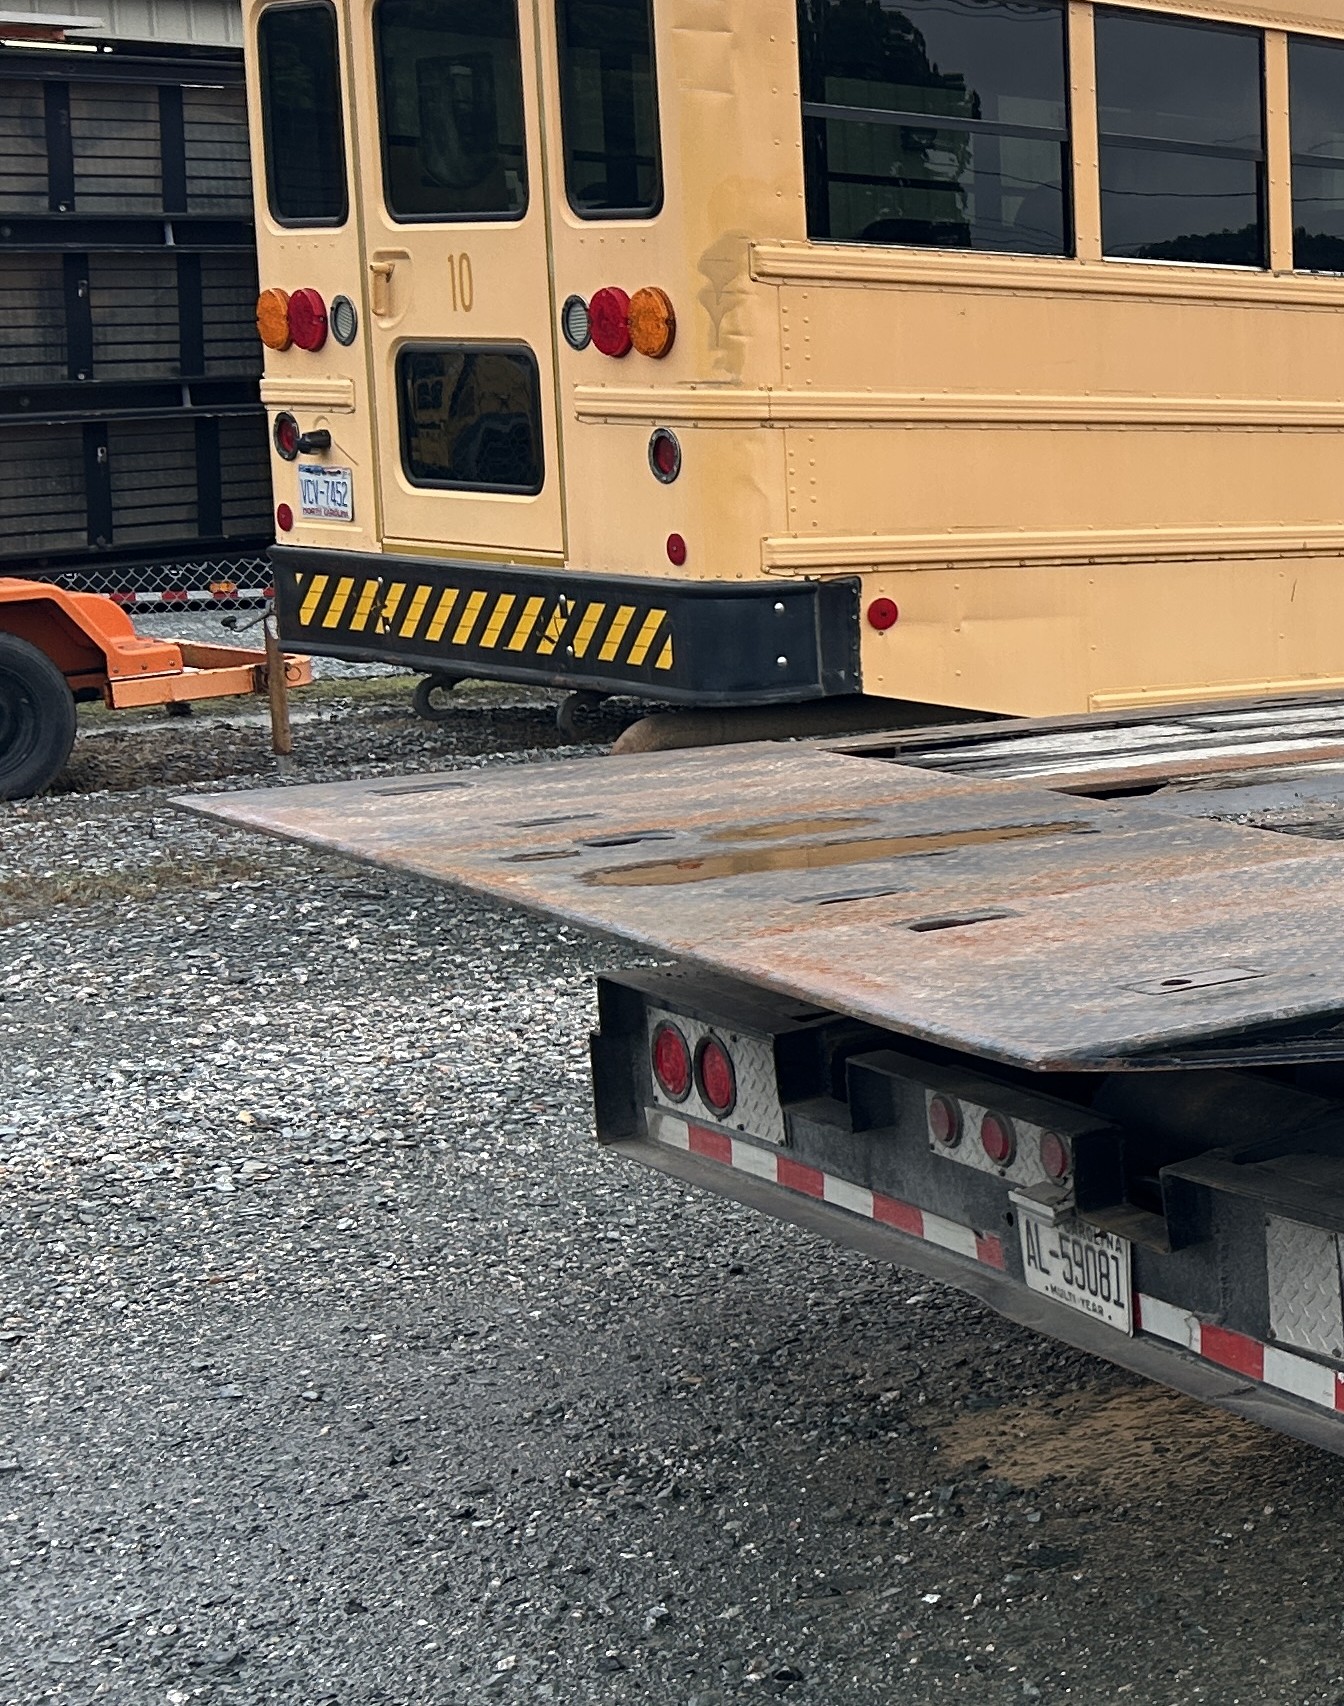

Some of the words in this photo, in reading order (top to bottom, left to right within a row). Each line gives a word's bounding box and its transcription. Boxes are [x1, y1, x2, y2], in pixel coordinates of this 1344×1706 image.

[447, 252, 474, 312] 10
[300, 479, 348, 507] VCV-7452
[1025, 1219, 1125, 1309] AL-59081
